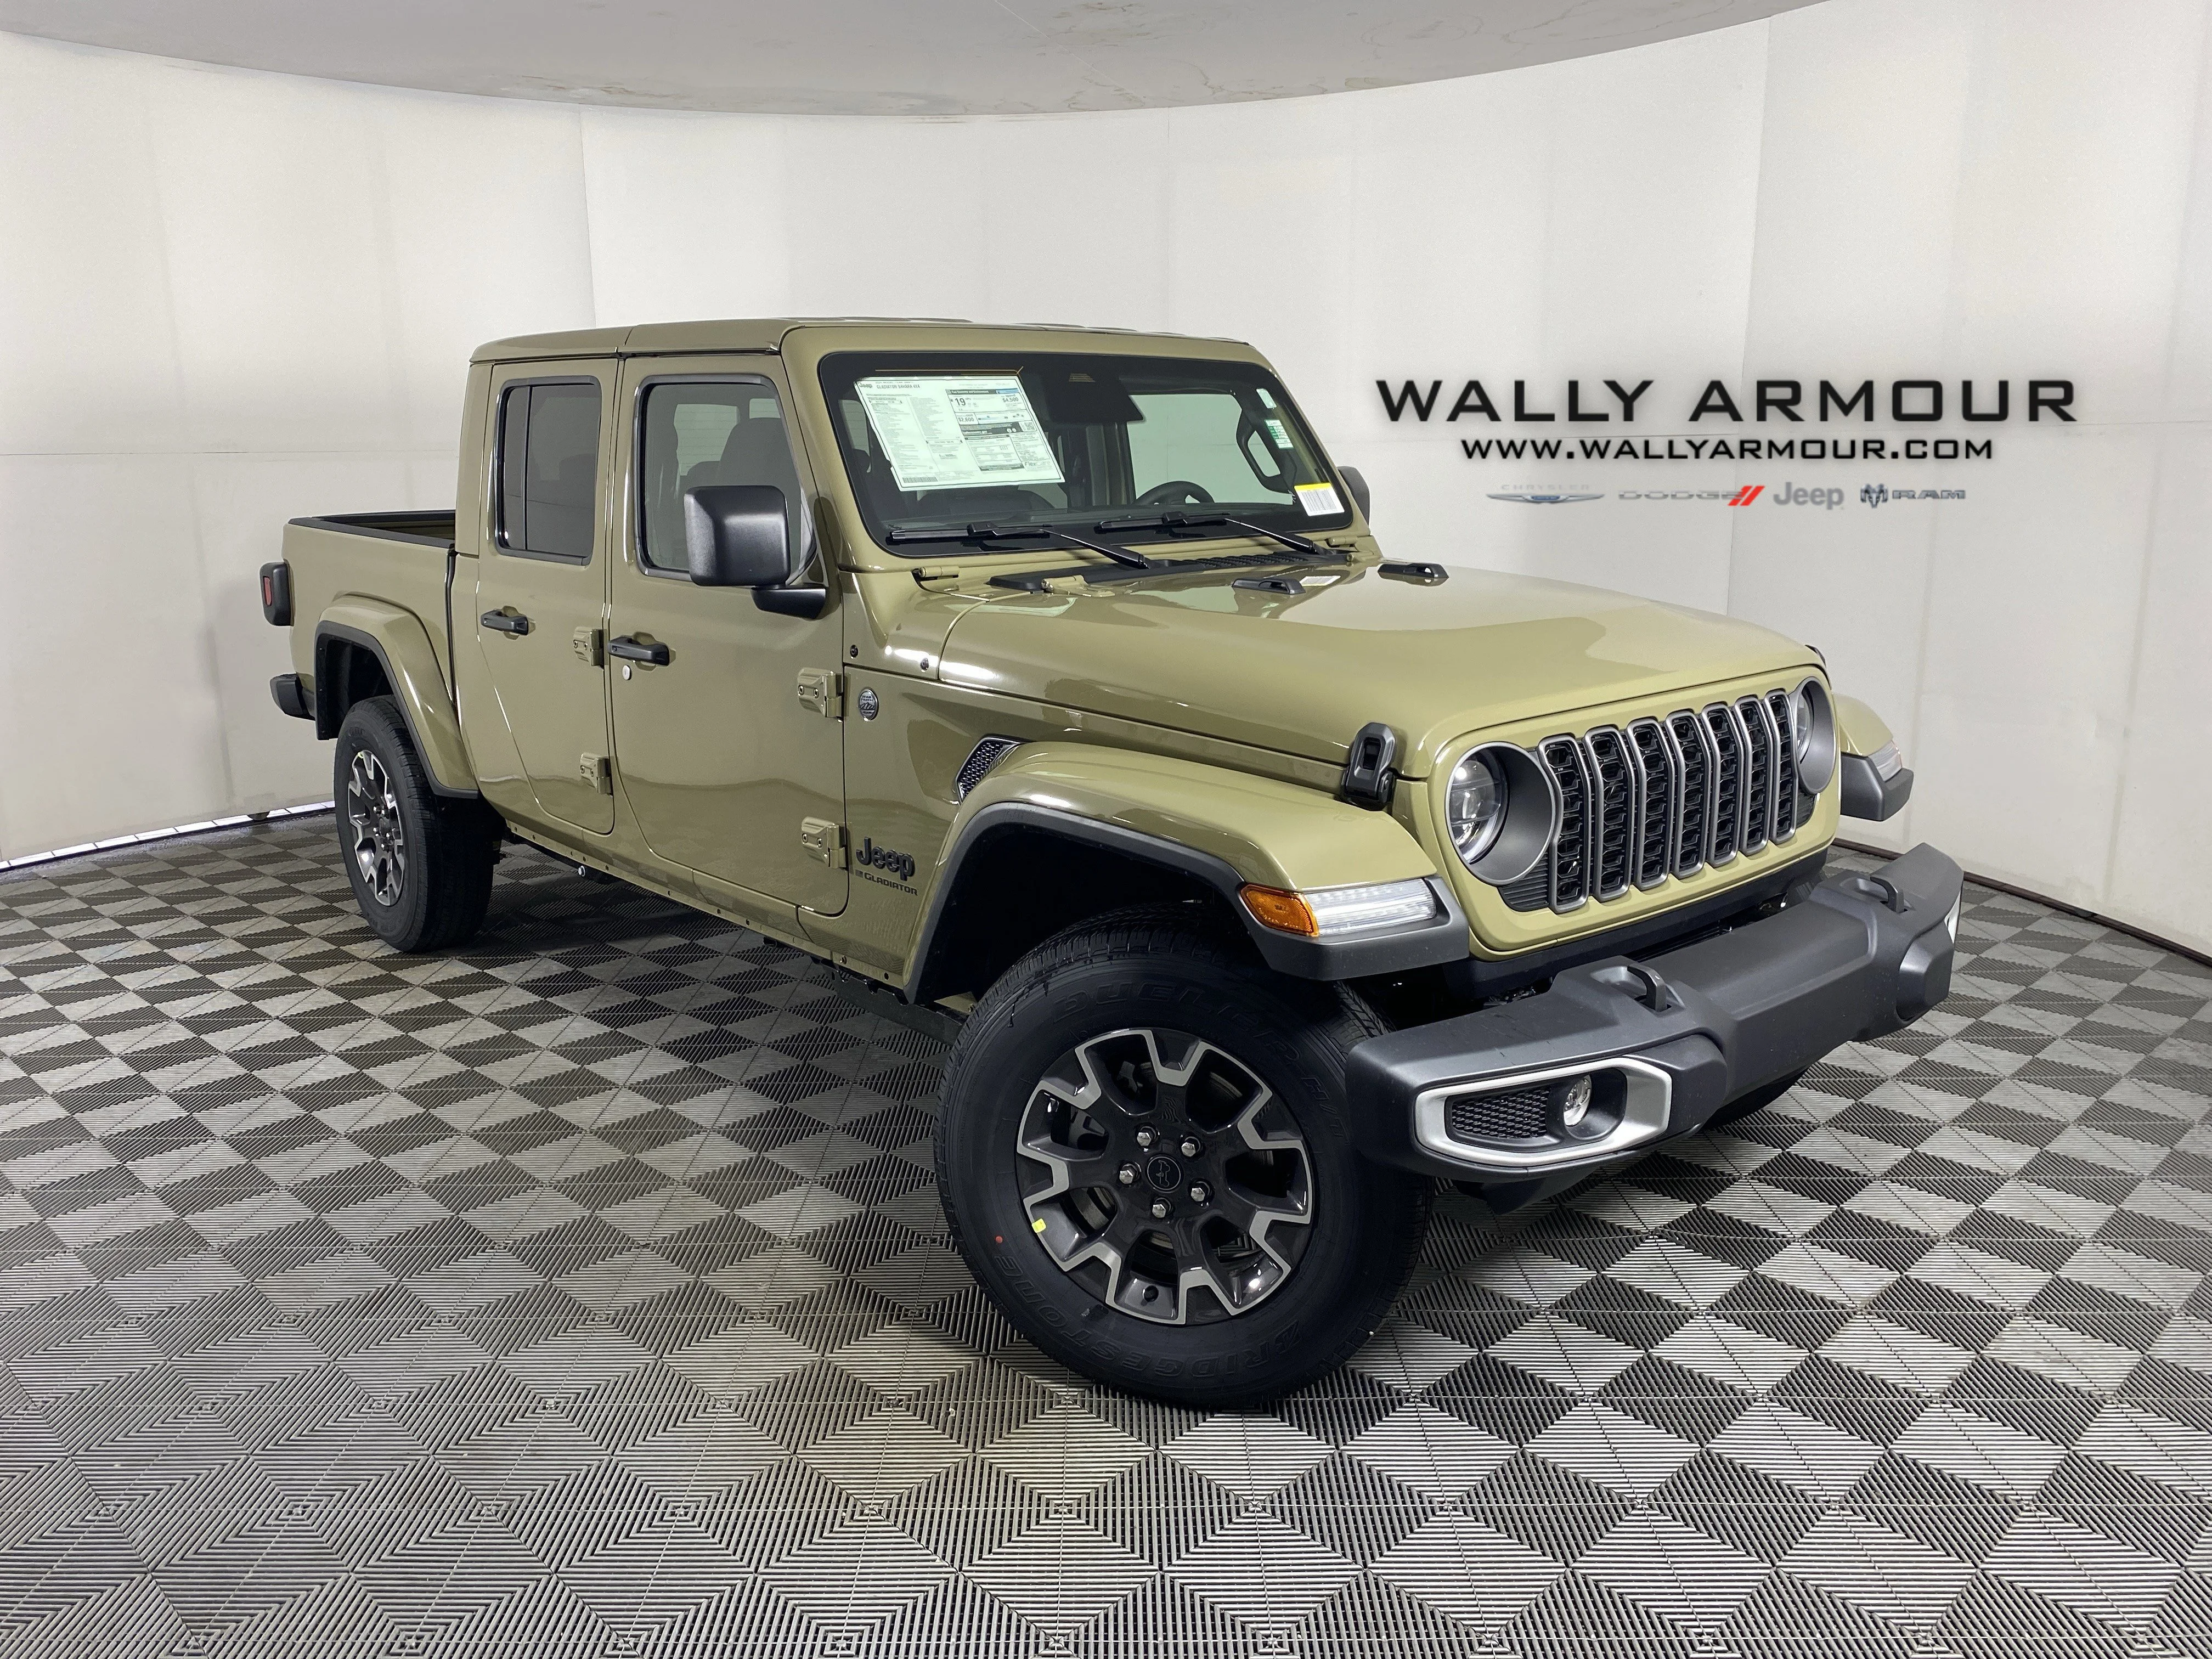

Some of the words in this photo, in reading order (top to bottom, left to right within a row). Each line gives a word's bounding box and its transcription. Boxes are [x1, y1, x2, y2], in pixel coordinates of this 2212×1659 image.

[955, 398, 966, 406] 19
[856, 836, 916, 882] Jeep
[864, 872, 918, 896] GLADIATOR
[1052, 979, 1301, 1063] DUELER
[994, 1255, 1301, 1378] BRIDGESTONE
